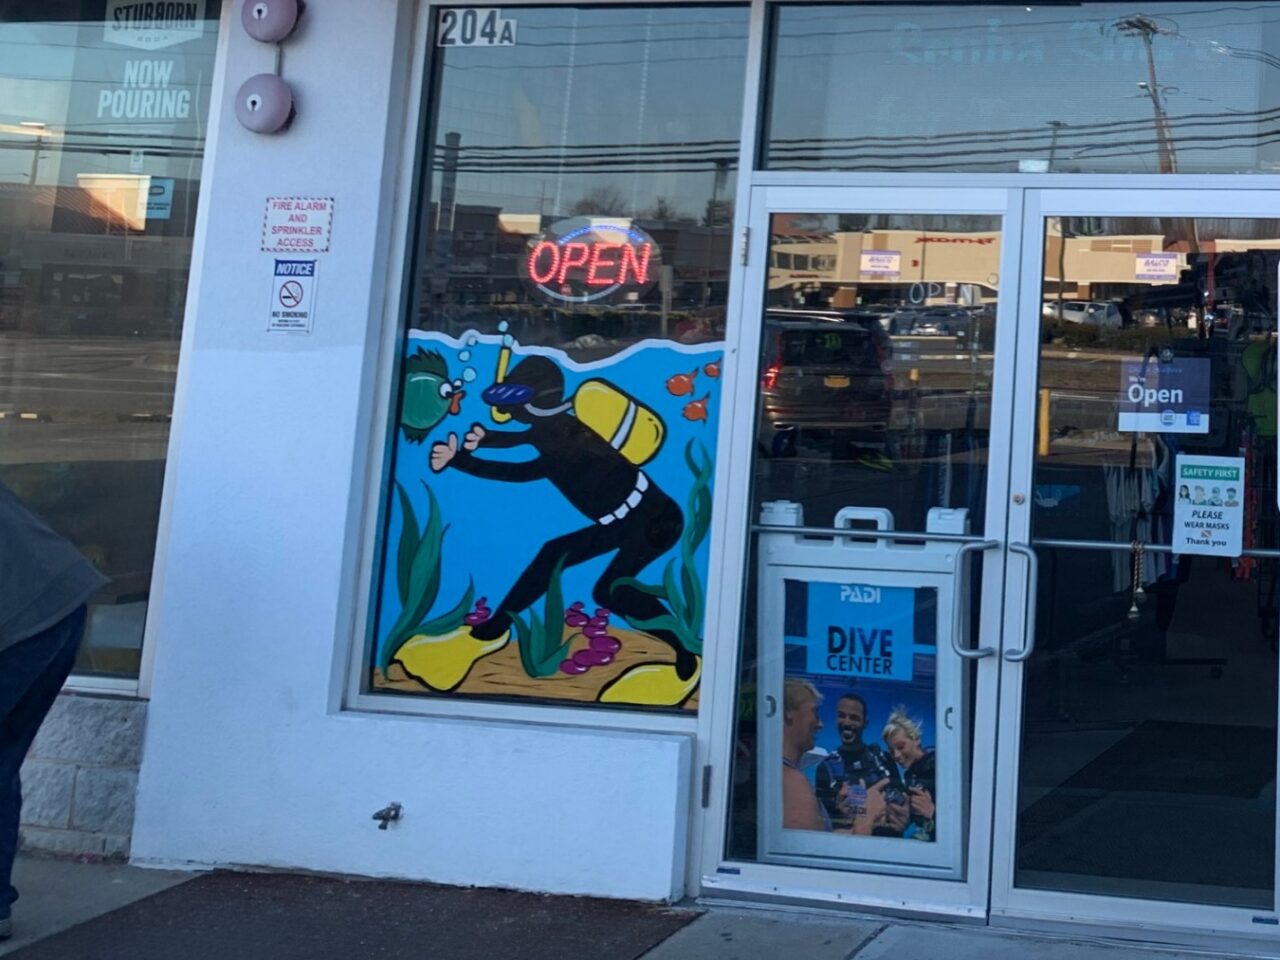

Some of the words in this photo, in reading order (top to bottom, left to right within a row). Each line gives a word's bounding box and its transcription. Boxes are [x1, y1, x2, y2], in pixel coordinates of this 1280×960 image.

[112, 1, 197, 31] STUBBORN
[123, 60, 173, 88] NOW
[97, 90, 191, 118] POURING
[272, 201, 292, 211] FIRE
[294, 201, 327, 211] ALARM
[288, 214, 307, 223] AND
[271, 225, 322, 235] SPRINKLER
[277, 238, 314, 247] ACCESS
[276, 262, 313, 275] NOTICE
[528, 240, 651, 285] OPEN
[282, 311, 308, 319] SMOKING
[1128, 383, 1183, 407] Open
[1181, 467, 1212, 477] SAFETY
[1214, 469, 1238, 478] FIRST
[1192, 510, 1224, 520] PLEASE
[1184, 521, 1205, 530] WEAR
[1206, 522, 1230, 530] MASKS
[1186, 537, 1210, 546] Thank
[1211, 539, 1227, 548] you
[840, 584, 881, 604] PADI
[827, 625, 893, 658] DIVE
[826, 654, 893, 675] CENTER
